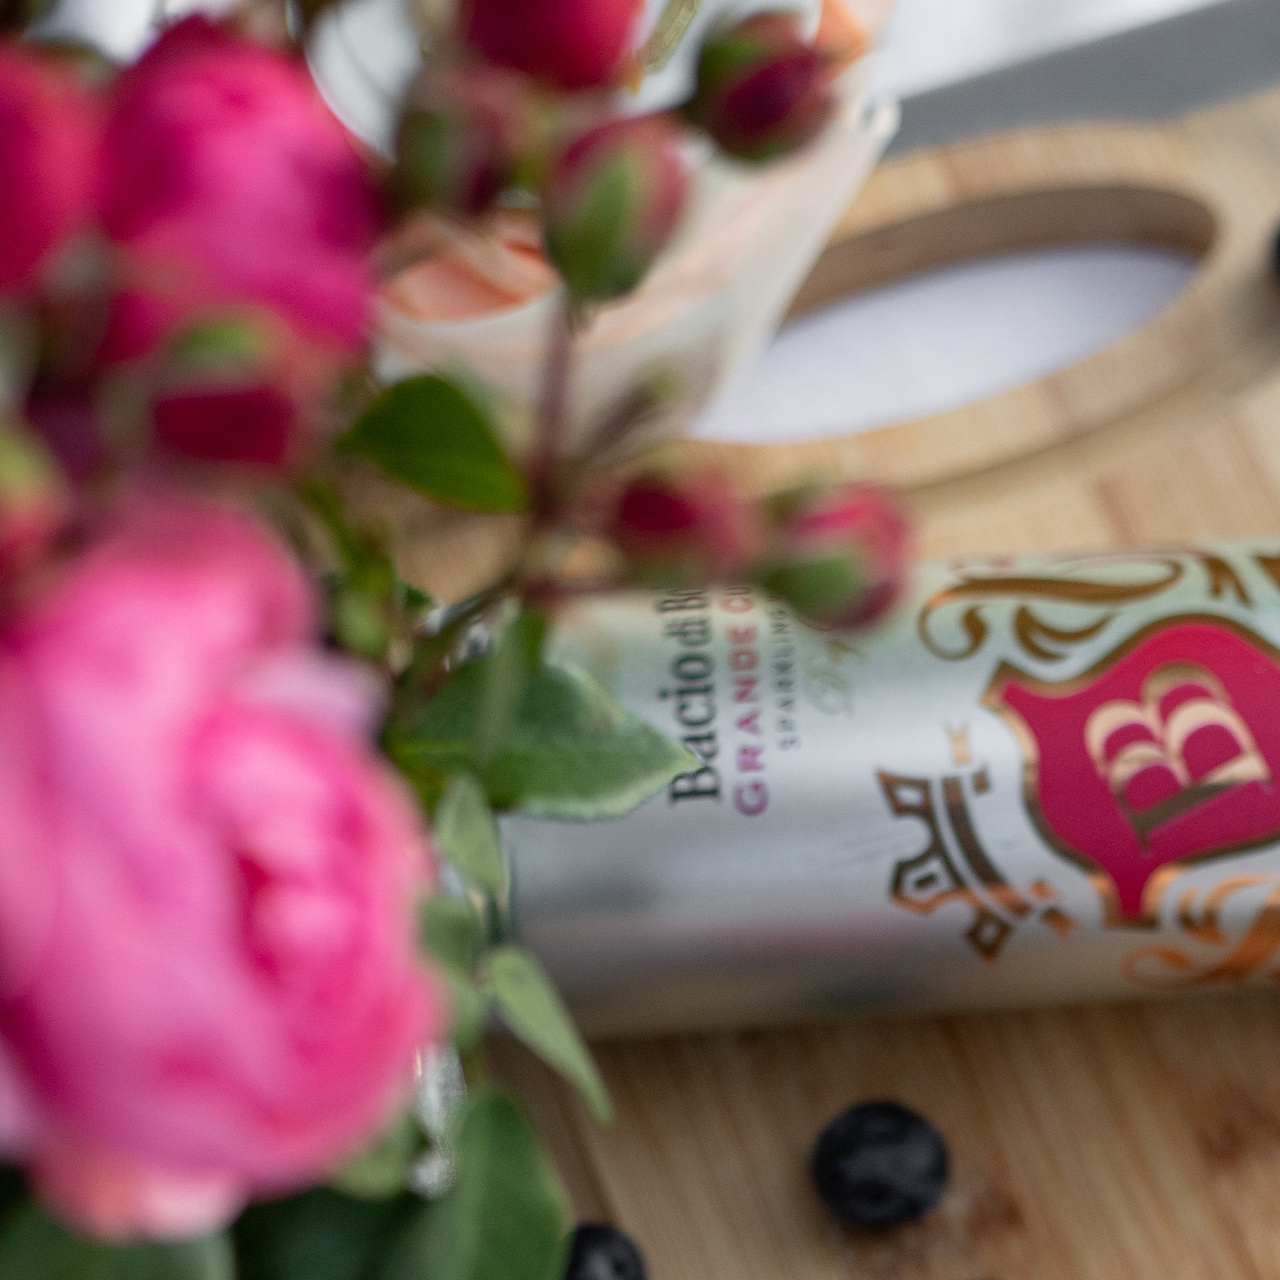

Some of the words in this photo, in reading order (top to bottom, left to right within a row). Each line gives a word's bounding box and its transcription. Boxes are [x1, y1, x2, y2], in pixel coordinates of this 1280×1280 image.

[662, 616, 712, 648] di
[657, 652, 720, 806] Bacio
[726, 626, 770, 817] GRANDE
